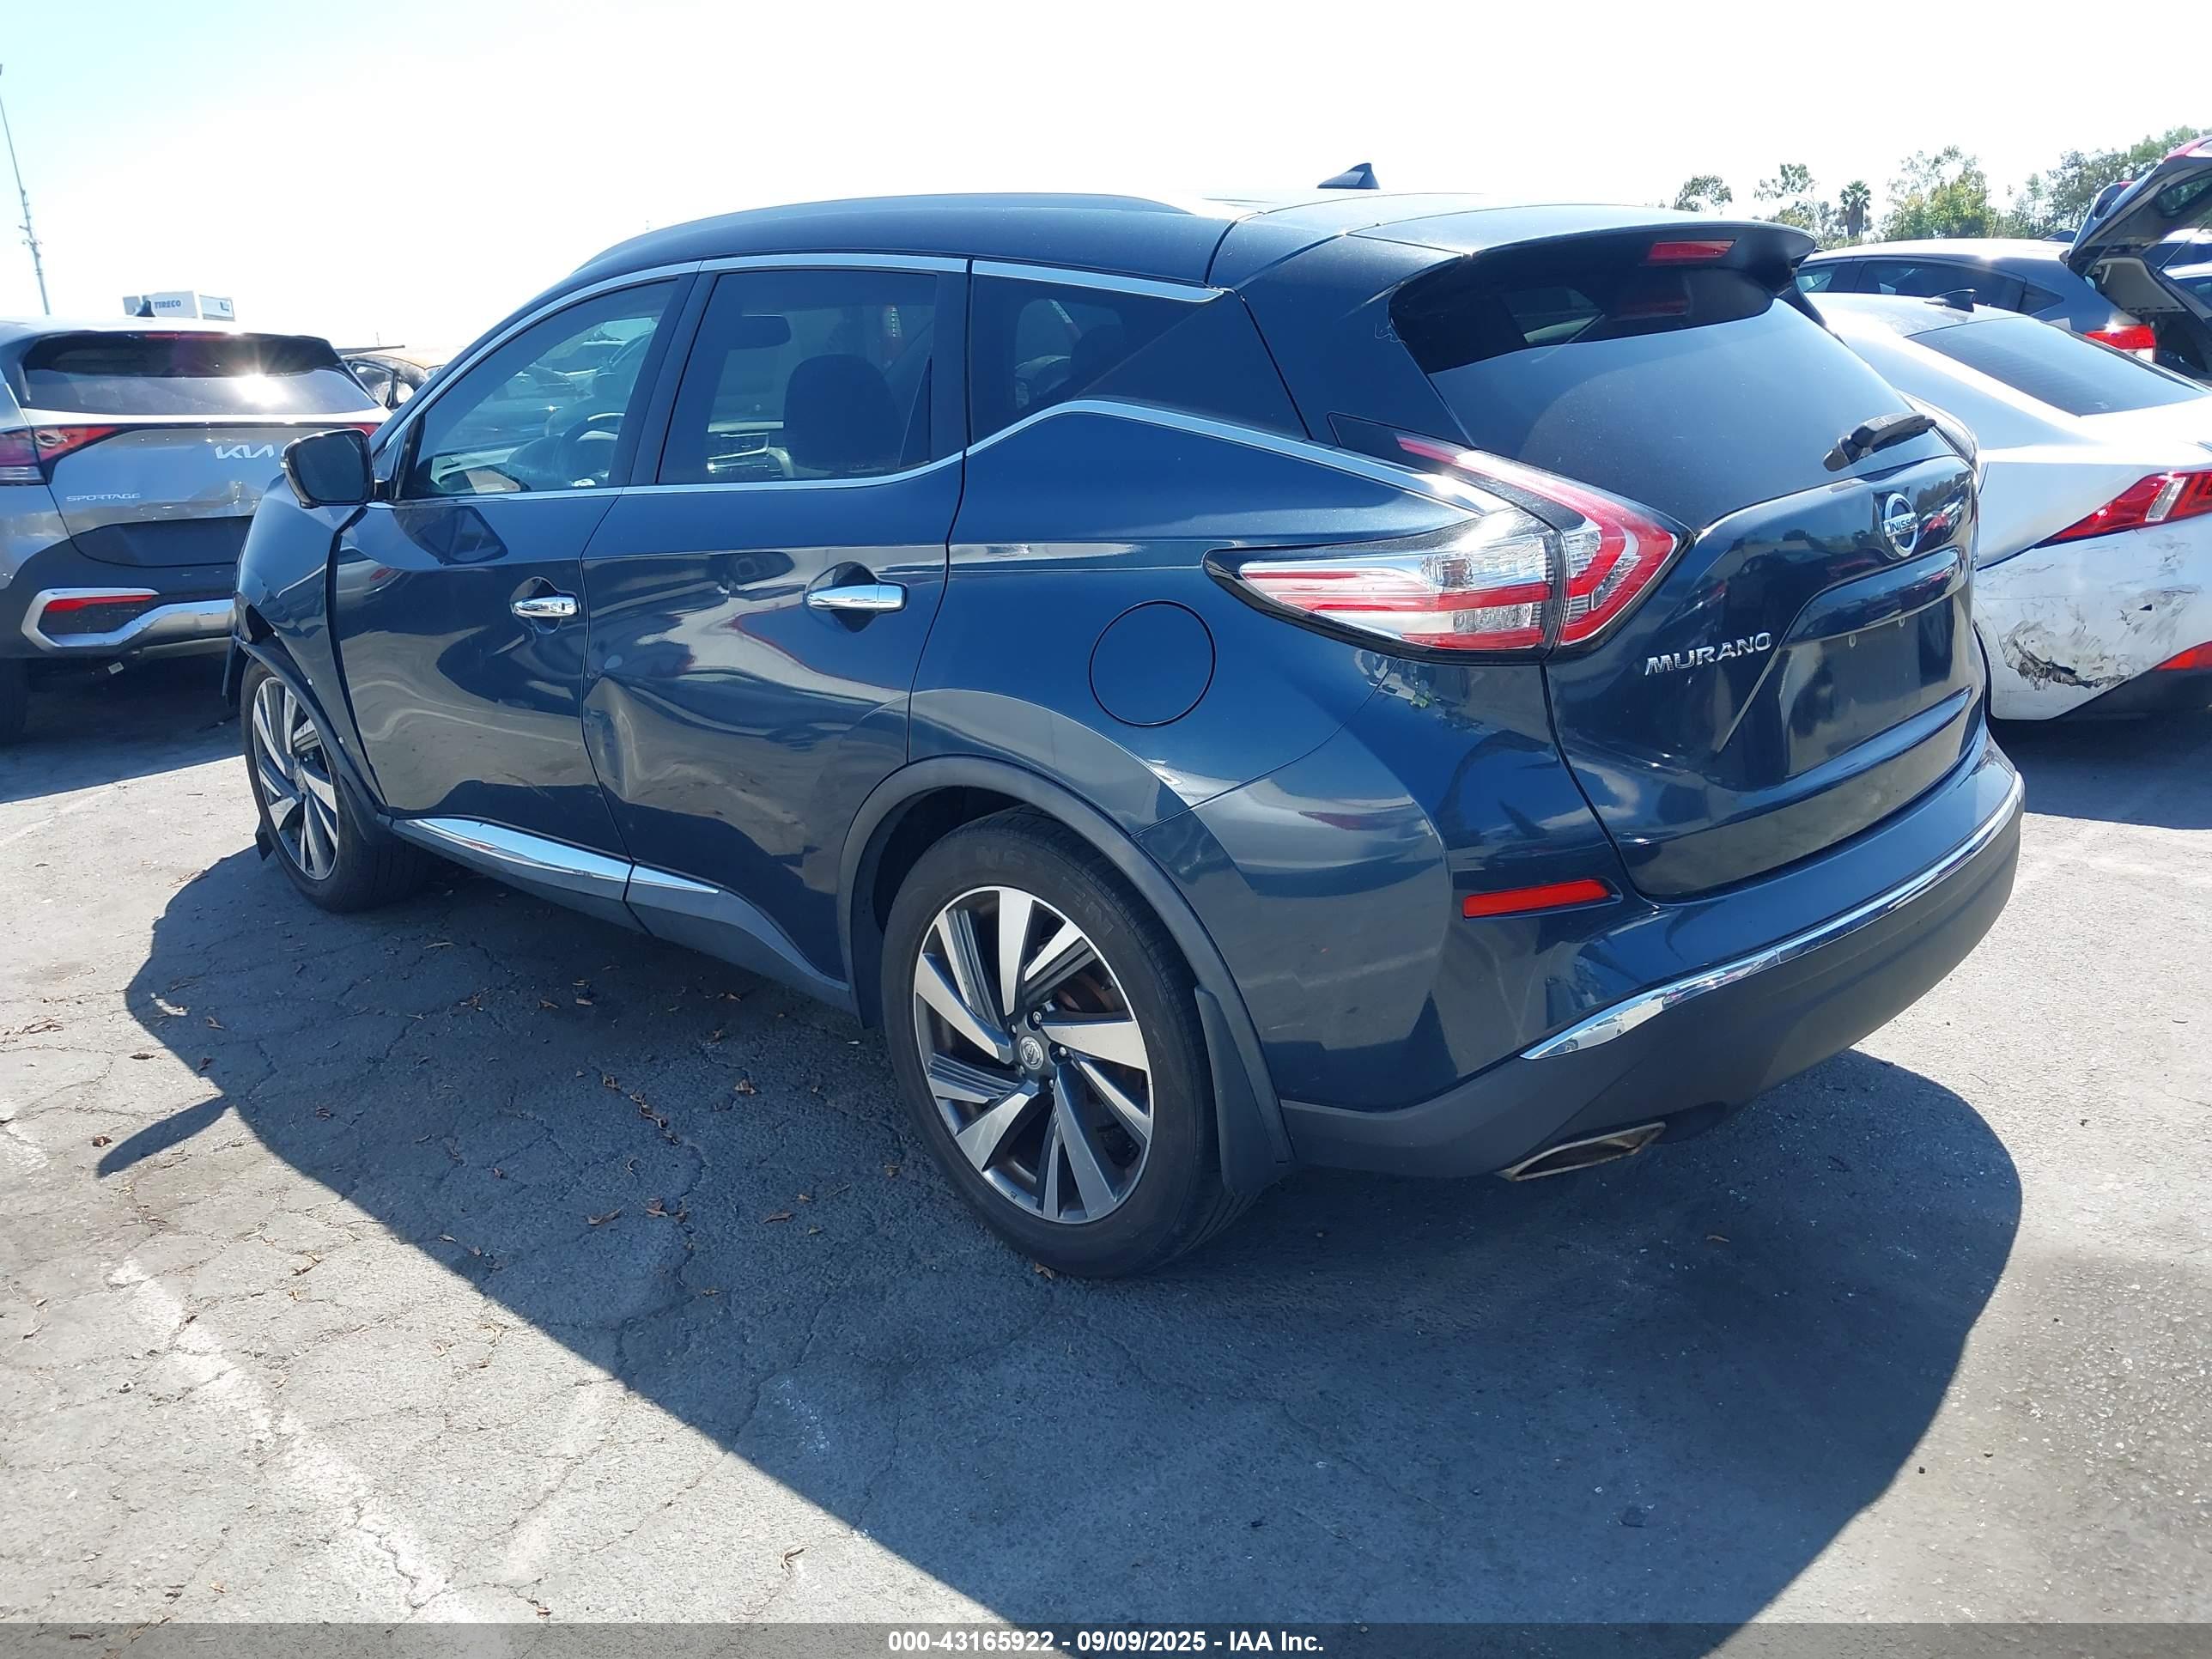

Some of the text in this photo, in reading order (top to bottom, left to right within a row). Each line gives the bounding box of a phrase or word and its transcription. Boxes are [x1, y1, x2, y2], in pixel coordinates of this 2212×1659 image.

[155, 300, 181, 309] TIRECO
[215, 444, 275, 459] KIA
[1644, 632, 1771, 676] MURANO
